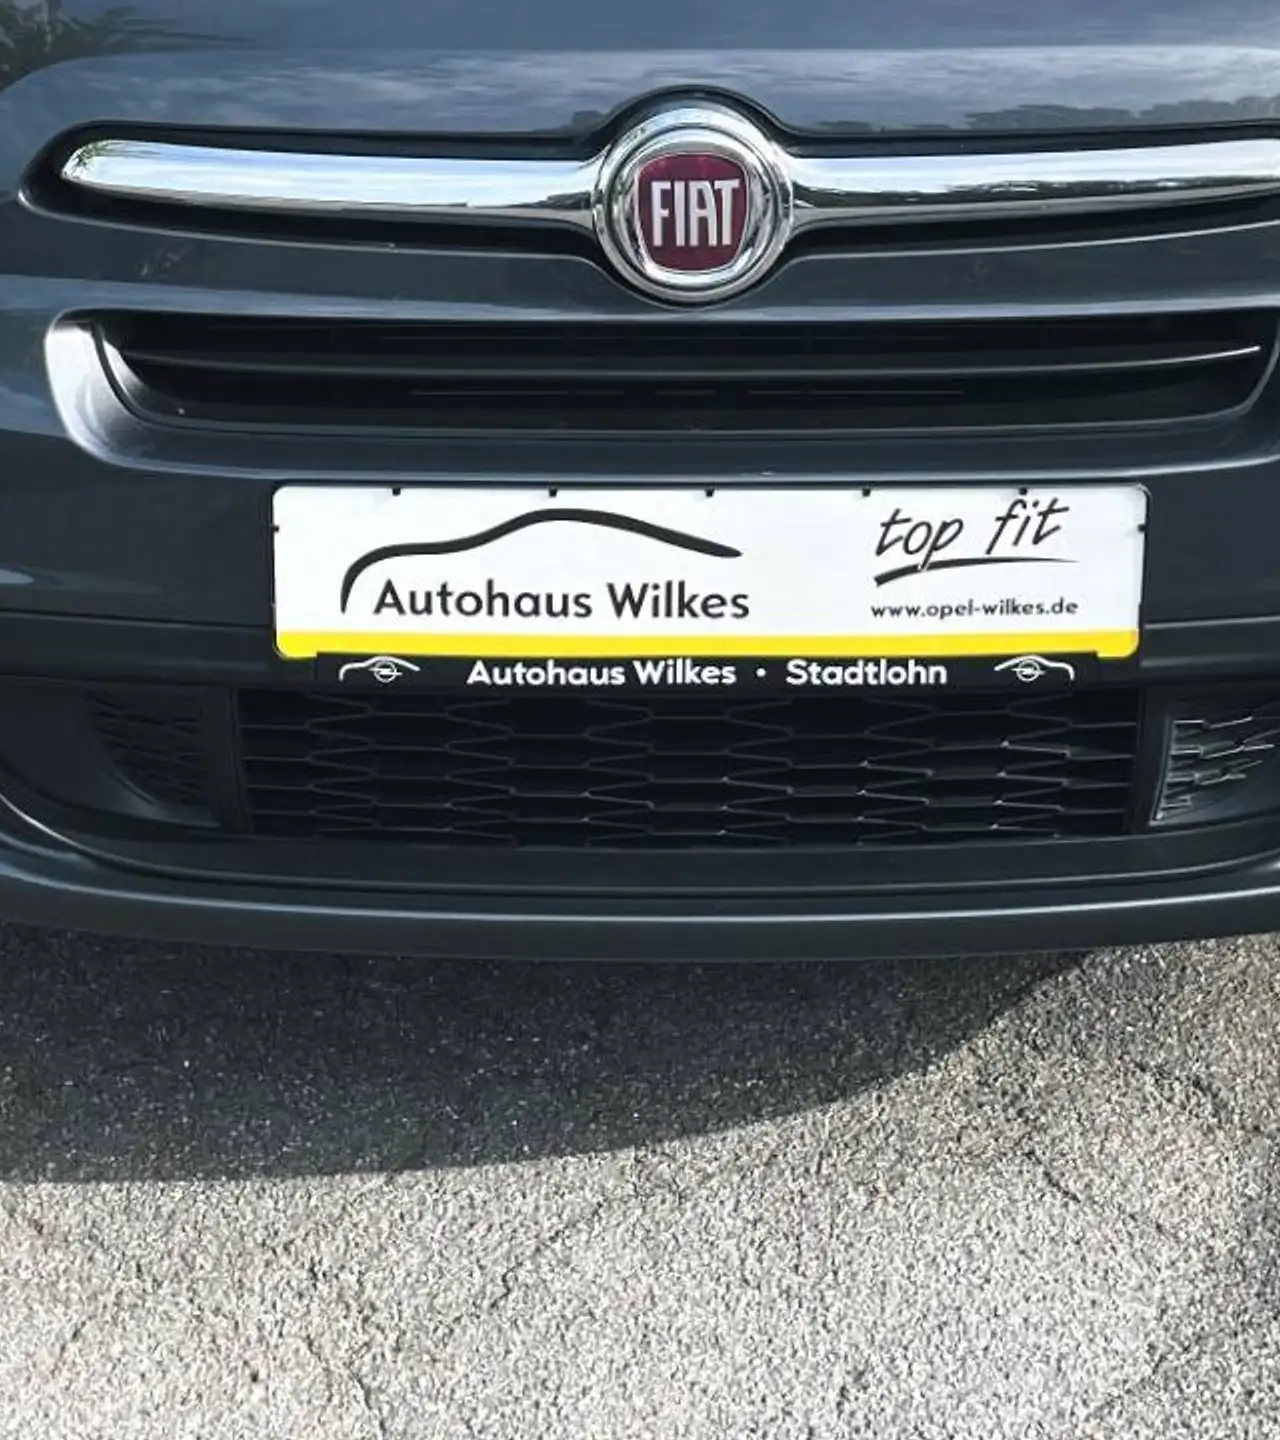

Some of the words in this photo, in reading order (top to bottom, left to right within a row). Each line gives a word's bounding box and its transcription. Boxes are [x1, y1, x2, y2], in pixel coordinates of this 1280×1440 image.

[650, 177, 741, 248] FIAT
[875, 508, 964, 571] top
[984, 496, 1070, 555] fit
[372, 577, 593, 619] Autohaus
[606, 579, 751, 620] Wilkes
[870, 597, 1080, 621] www.opel-wilkes.de
[465, 658, 626, 686] Autohaus
[632, 657, 738, 686] Wilkes
[785, 658, 948, 686] Stadtlohn
